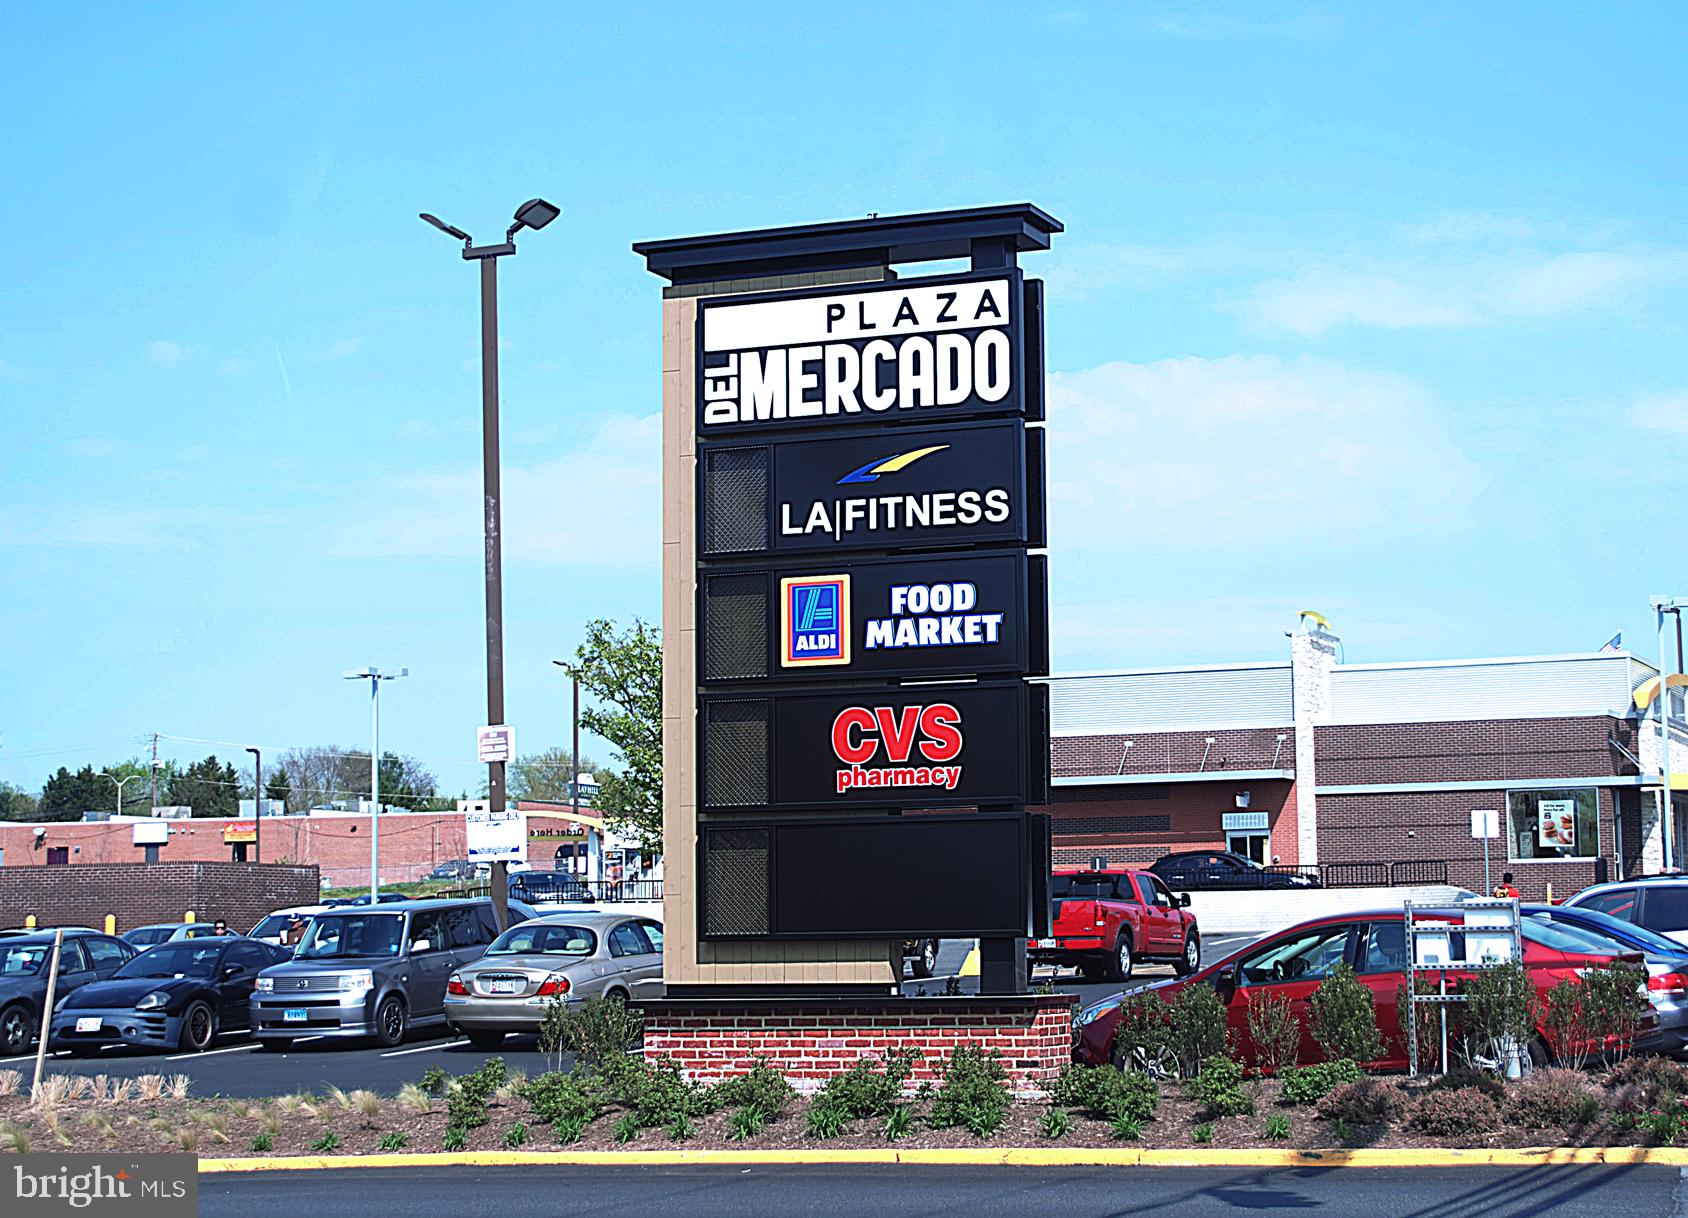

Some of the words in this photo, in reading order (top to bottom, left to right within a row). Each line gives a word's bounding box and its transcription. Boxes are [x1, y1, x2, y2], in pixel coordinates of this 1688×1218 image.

[827, 288, 1002, 334] PLAZA
[704, 353, 739, 424] DEL
[739, 329, 1011, 422] MERCADO
[891, 582, 977, 614] FOOD
[795, 633, 837, 651] ALDI
[865, 612, 1004, 649] MARKET
[831, 703, 964, 764] CVS
[836, 764, 962, 794] pharmacy
